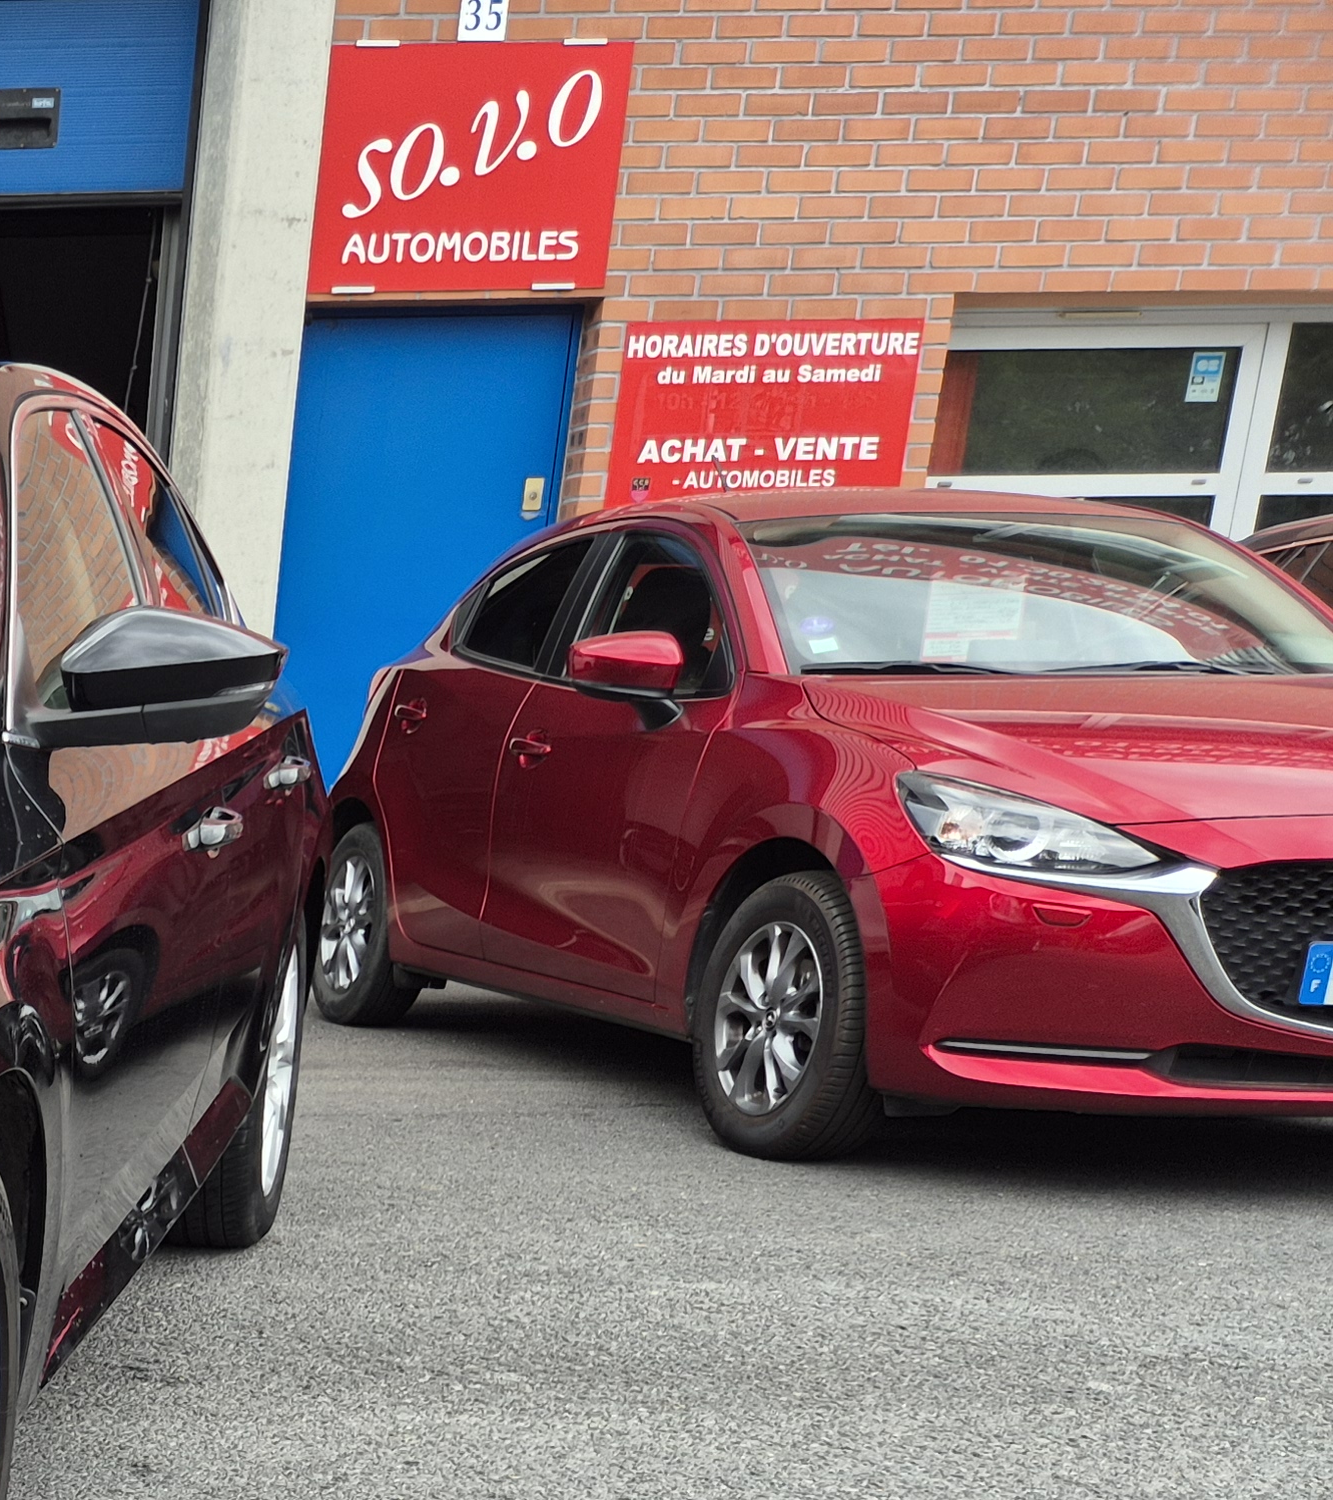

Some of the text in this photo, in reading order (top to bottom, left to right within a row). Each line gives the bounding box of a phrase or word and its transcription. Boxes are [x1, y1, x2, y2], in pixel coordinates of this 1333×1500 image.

[464, 0, 503, 31] 35
[341, 230, 579, 264] AUTOMOBILES
[627, 332, 920, 359] HORAIRES D'OUVERTURE
[657, 364, 881, 385] du Mardi au Samedi
[636, 438, 746, 464] ACHAT
[774, 436, 880, 461] VENTE
[1309, 979, 1322, 993] F
